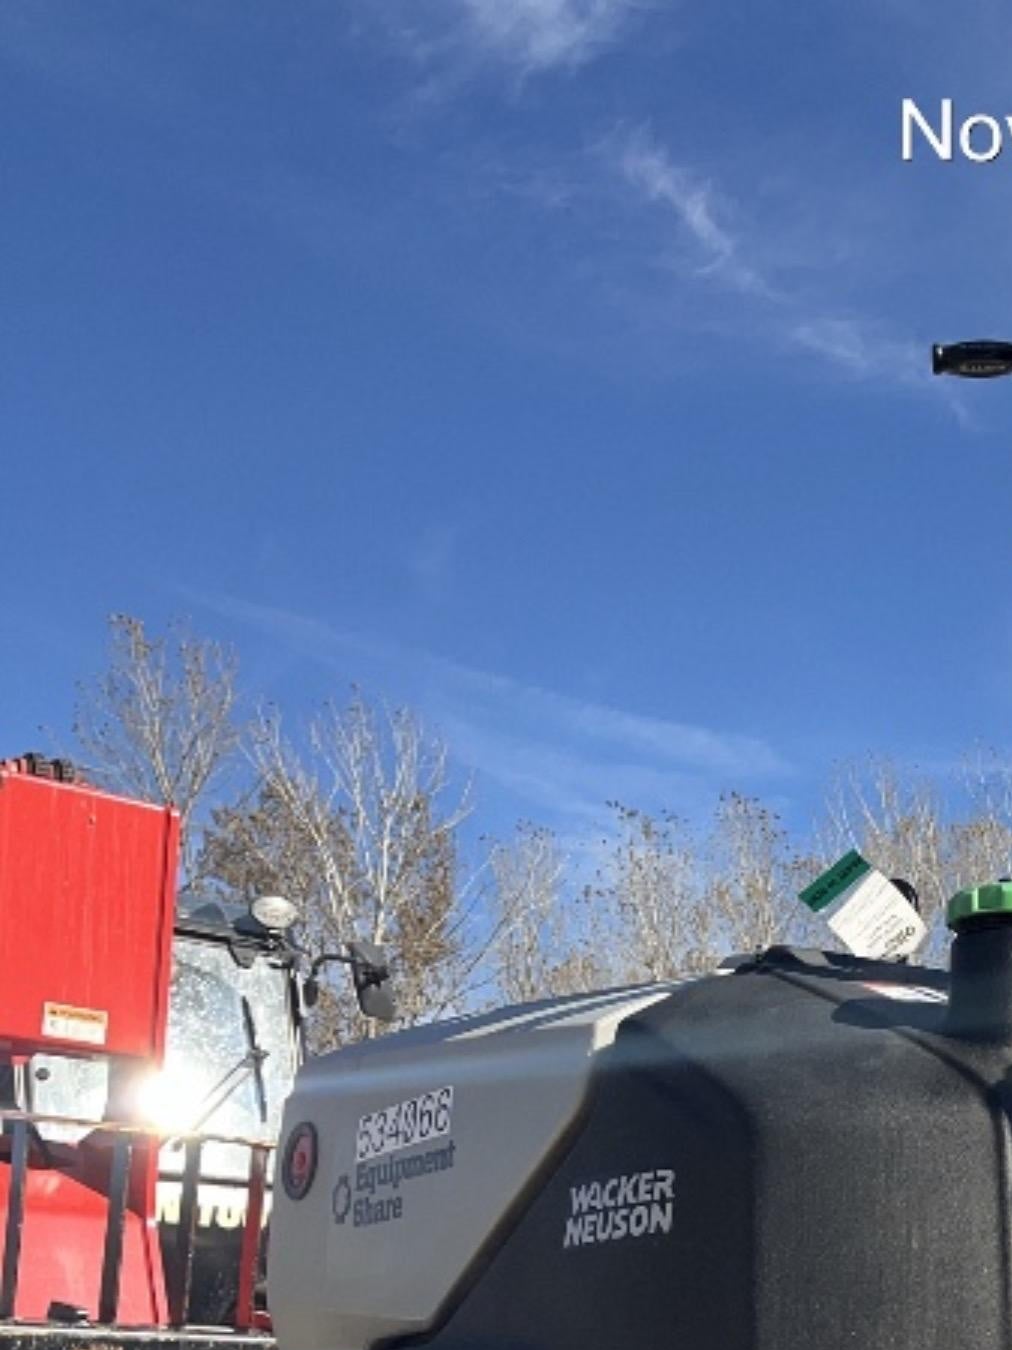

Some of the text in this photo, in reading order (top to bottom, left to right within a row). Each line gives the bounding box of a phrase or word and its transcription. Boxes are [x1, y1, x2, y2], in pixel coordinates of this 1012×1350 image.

[355, 1139, 456, 1195] Equipment
[352, 1196, 403, 1228] Share
[569, 1168, 676, 1216] WACKER
[563, 1202, 673, 1249] NEUSON
